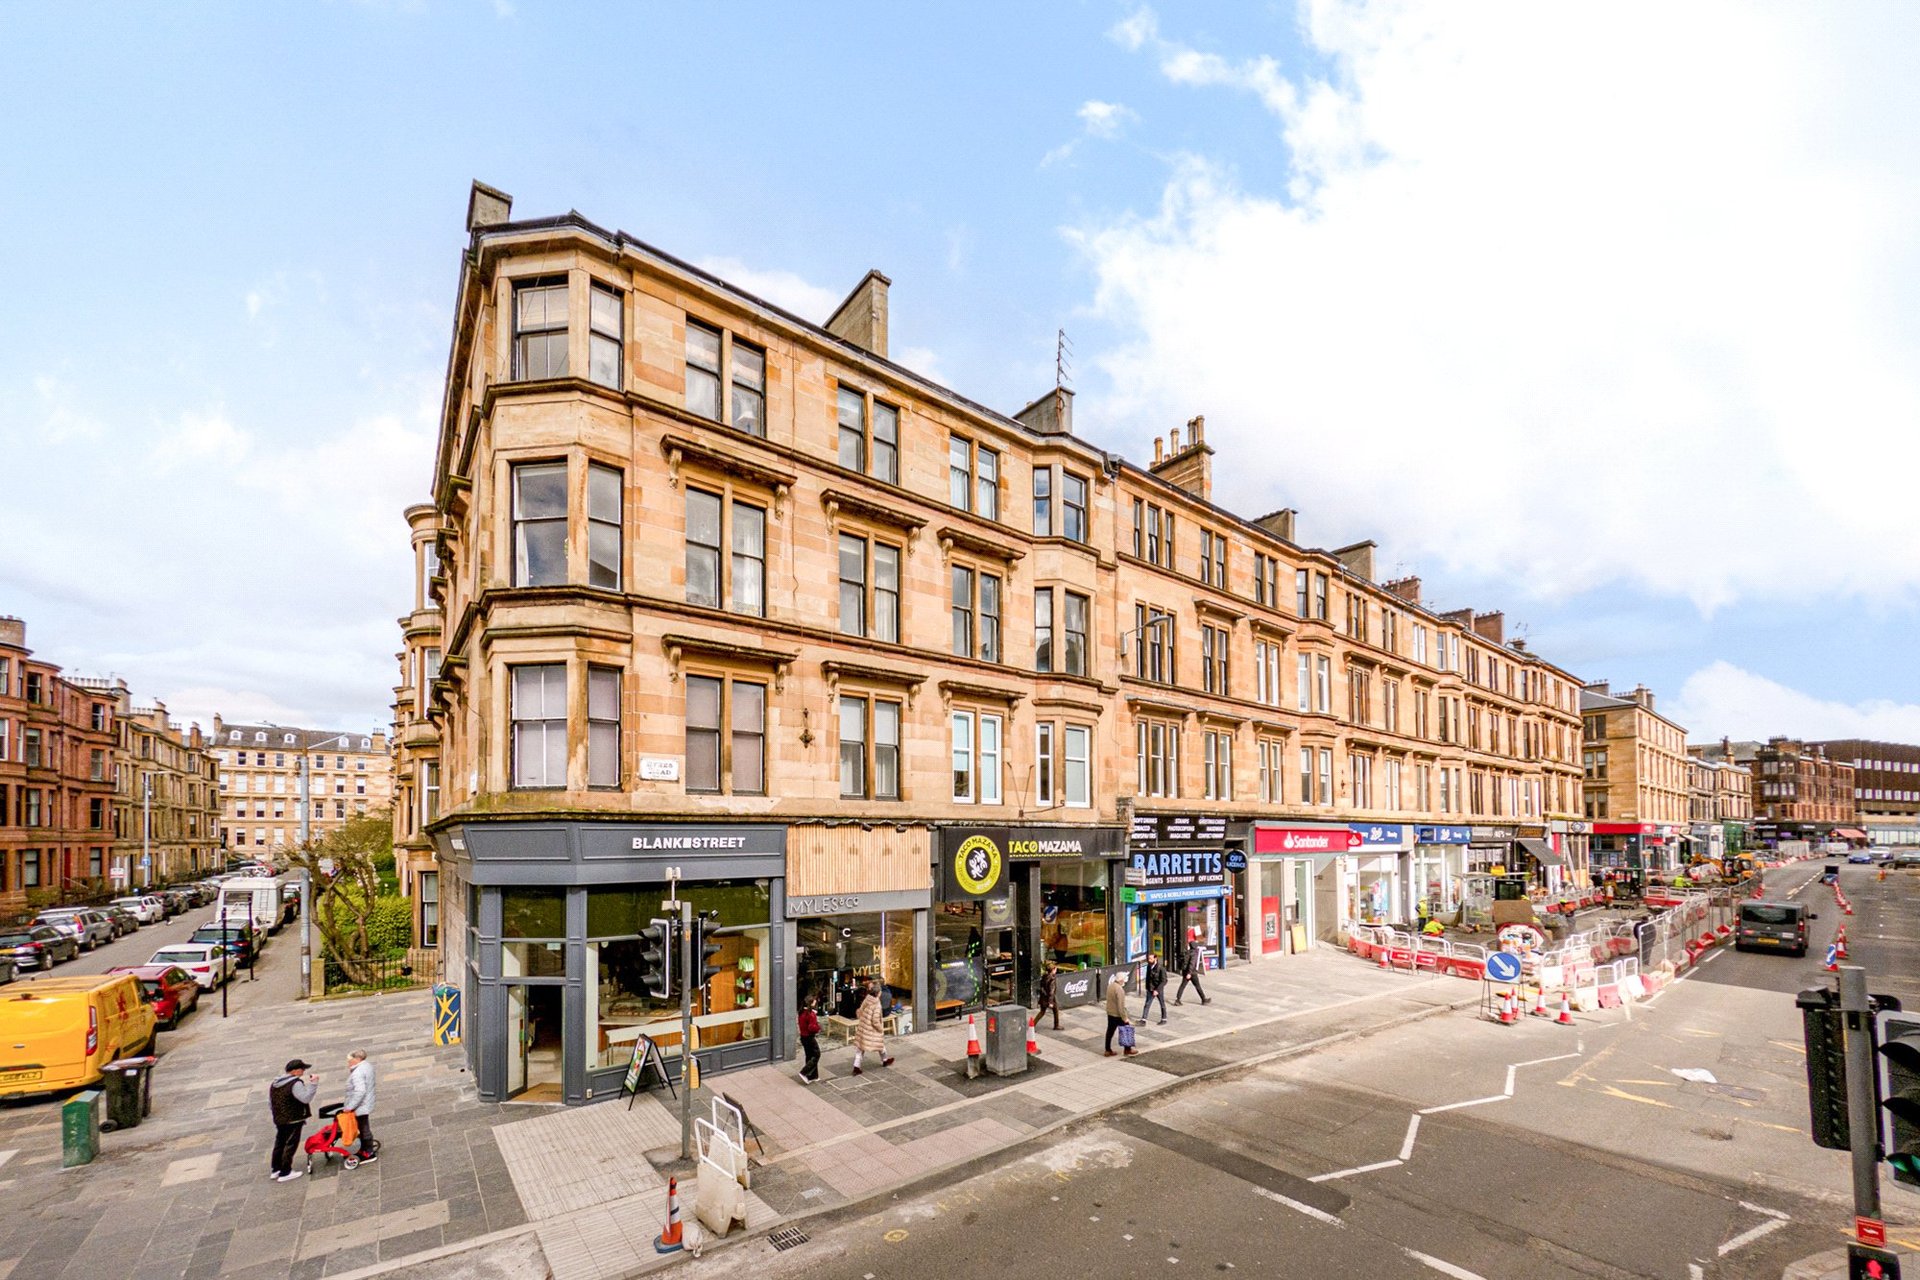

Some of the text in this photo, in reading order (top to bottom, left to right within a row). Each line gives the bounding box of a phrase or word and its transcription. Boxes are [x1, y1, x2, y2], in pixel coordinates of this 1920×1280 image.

[632, 837, 745, 849] BLANK STREET
[1293, 835, 1329, 849] Santander
[958, 840, 972, 859] TACO
[1134, 853, 1221, 875] BARRETTS
[852, 963, 880, 977] MYLE
